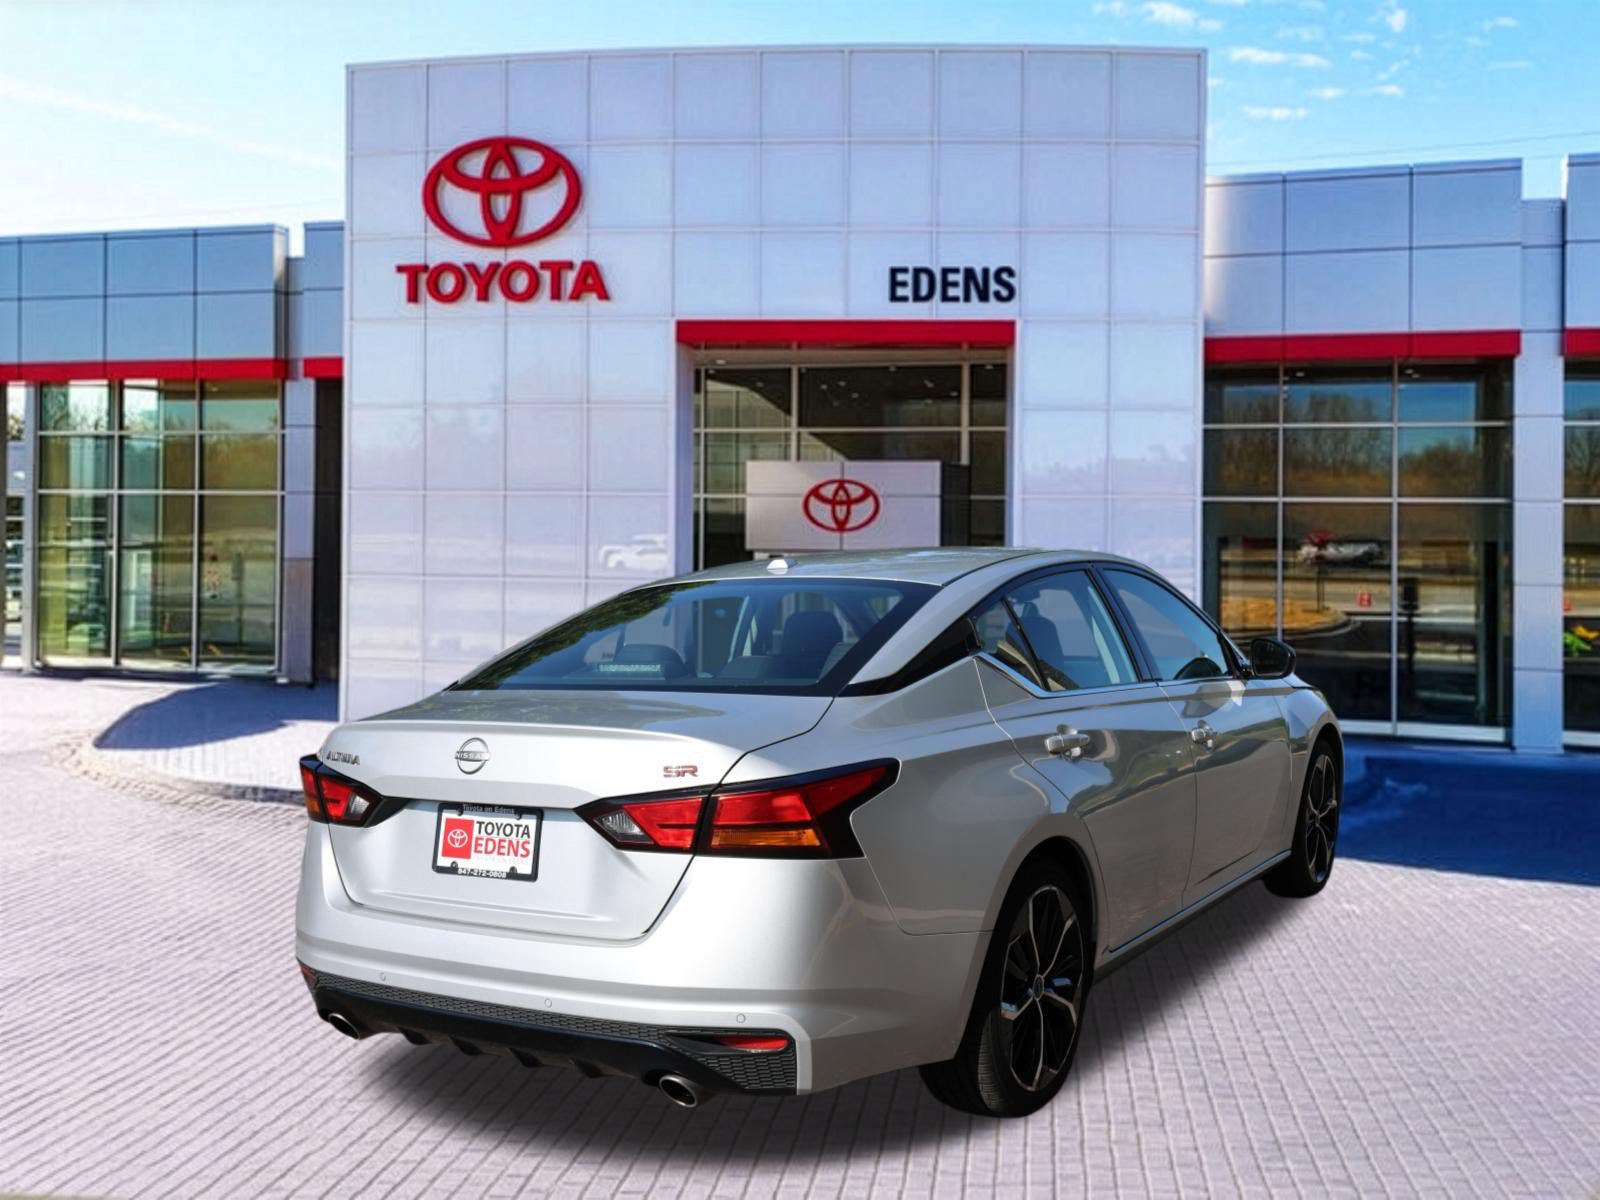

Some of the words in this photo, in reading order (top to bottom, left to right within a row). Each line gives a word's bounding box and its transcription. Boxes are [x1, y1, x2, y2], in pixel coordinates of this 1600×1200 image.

[396, 260, 609, 303] TOYOTA
[889, 266, 1016, 303] EDENS
[455, 751, 488, 761] NISSA
[663, 765, 698, 777] SR
[476, 821, 530, 838] TOYOTA
[474, 837, 530, 858] EDENS
